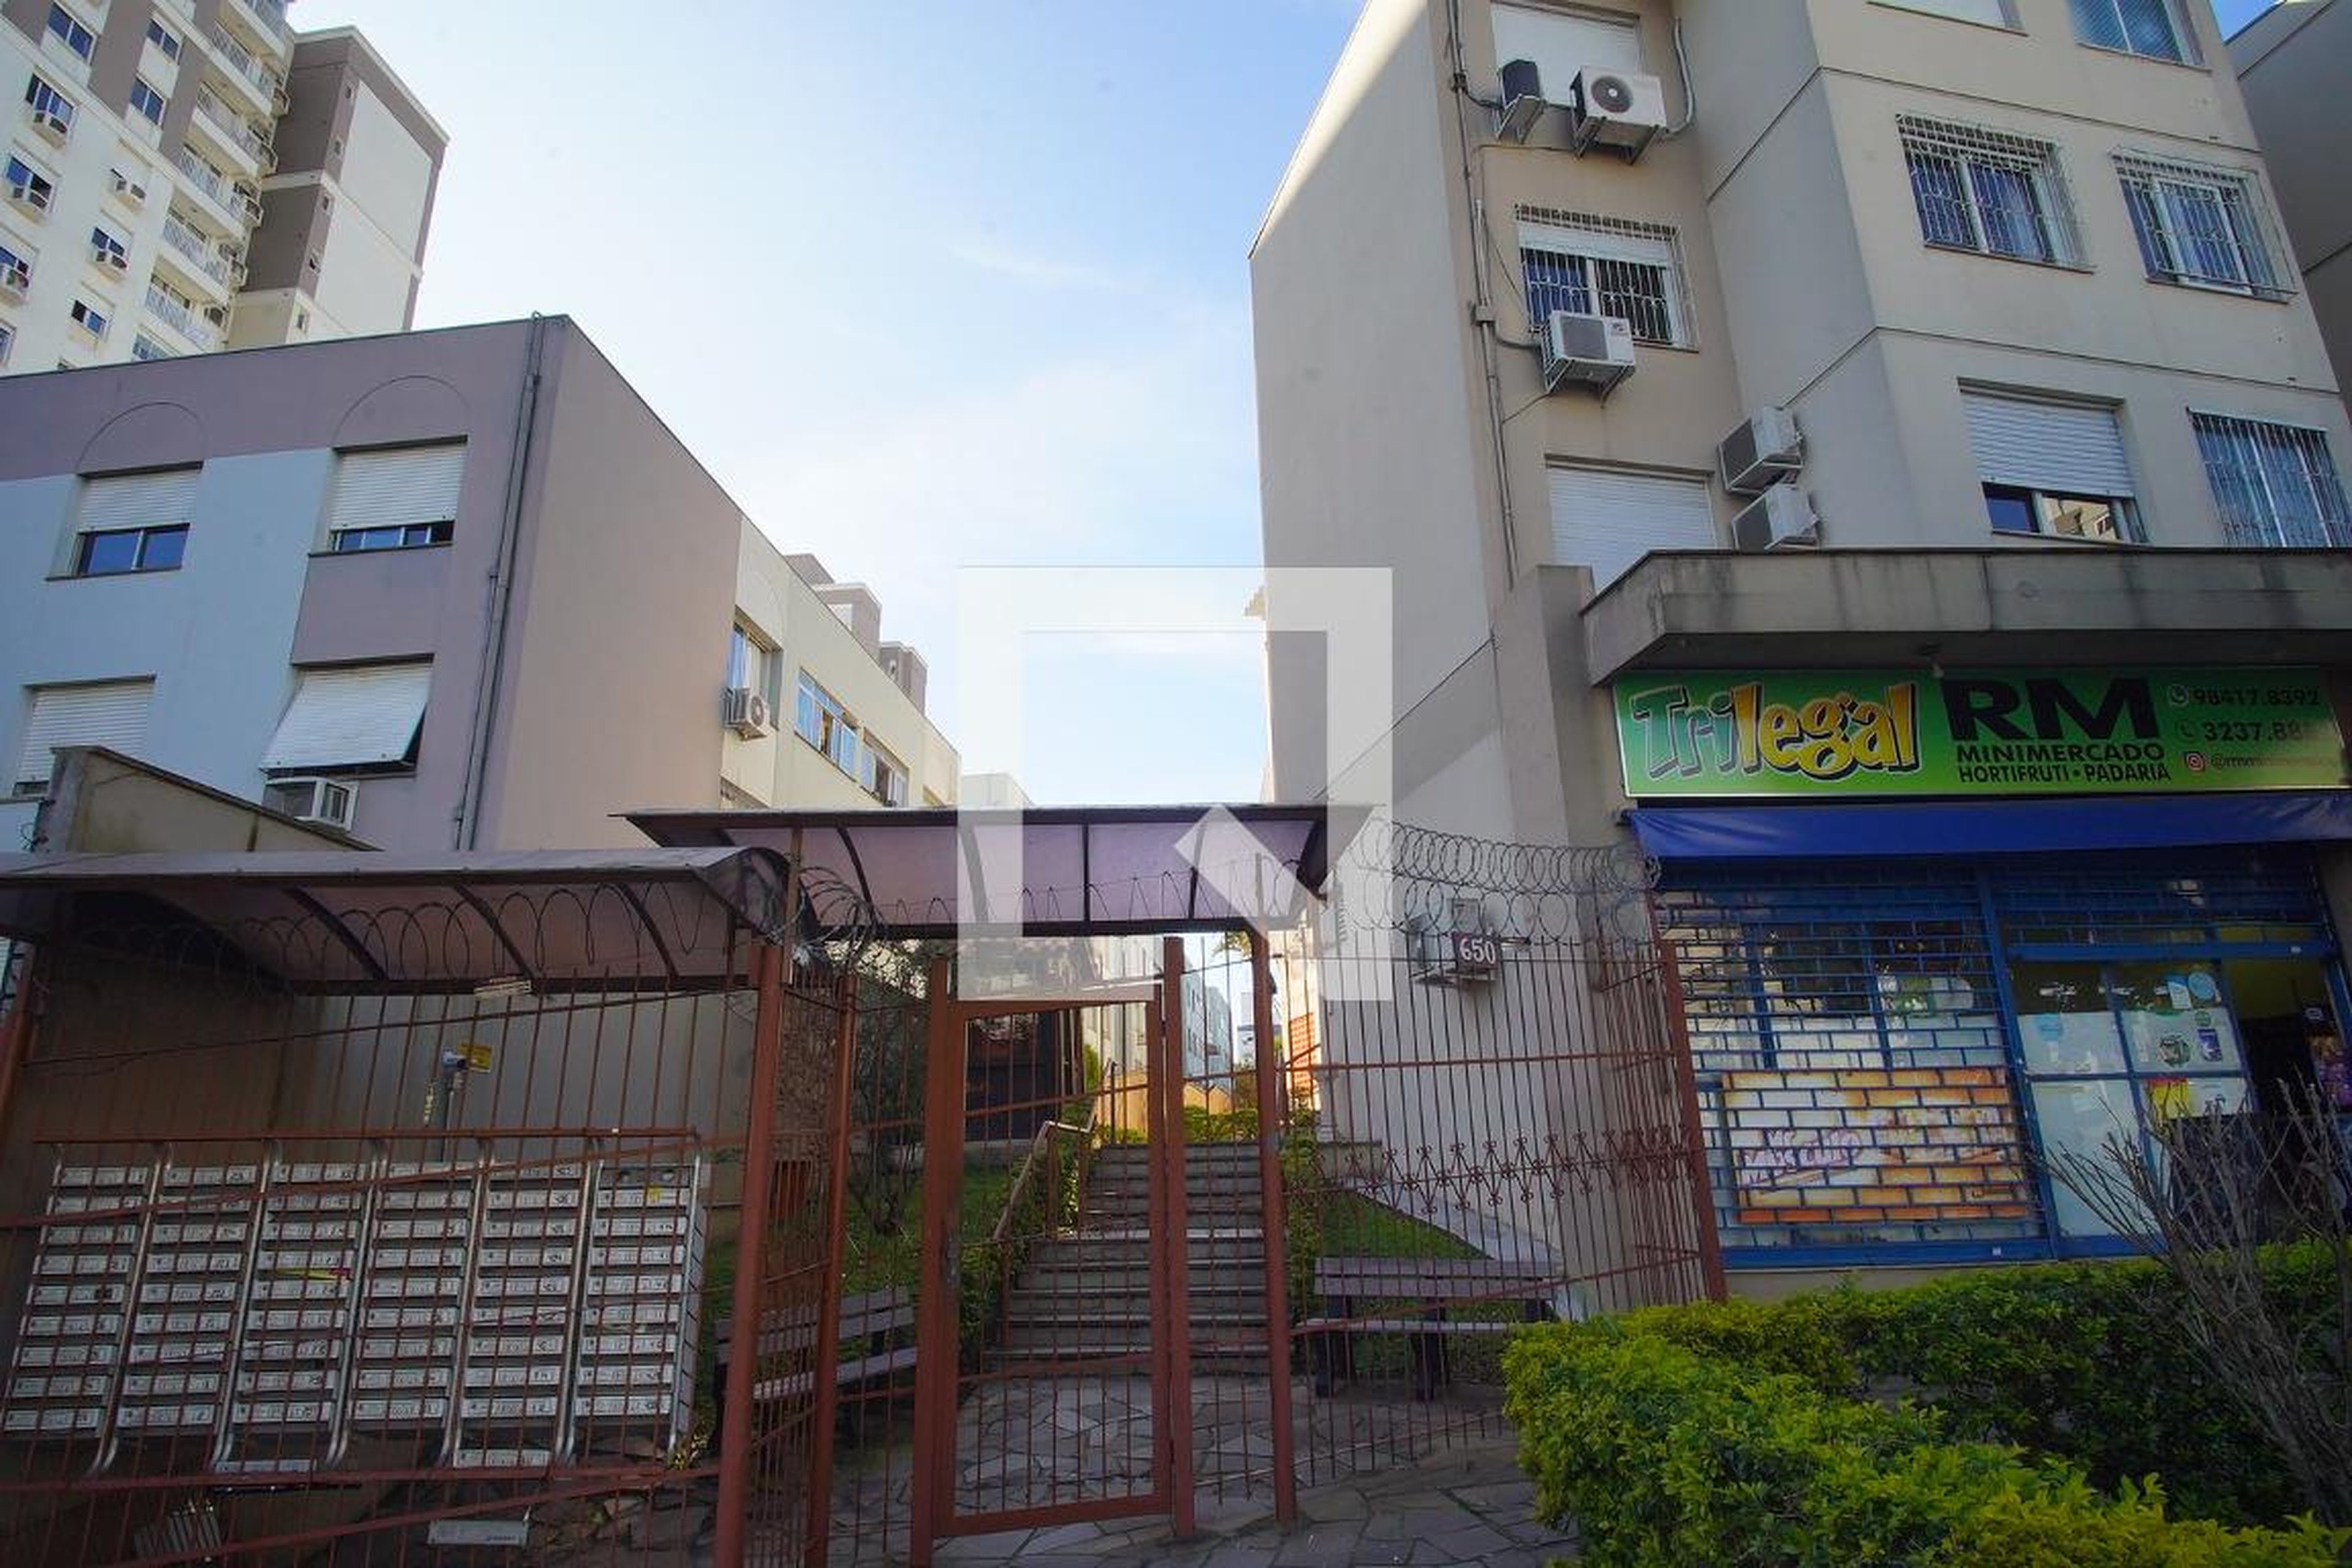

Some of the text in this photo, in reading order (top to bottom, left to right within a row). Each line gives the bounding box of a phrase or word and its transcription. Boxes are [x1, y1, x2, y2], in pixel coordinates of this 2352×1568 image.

[1939, 677, 2160, 742] RM
[1958, 742, 2165, 763] MINIMERCADO
[1959, 763, 2171, 784] HORTIFRUTI PADARIA
[1459, 937, 1496, 965] 650
